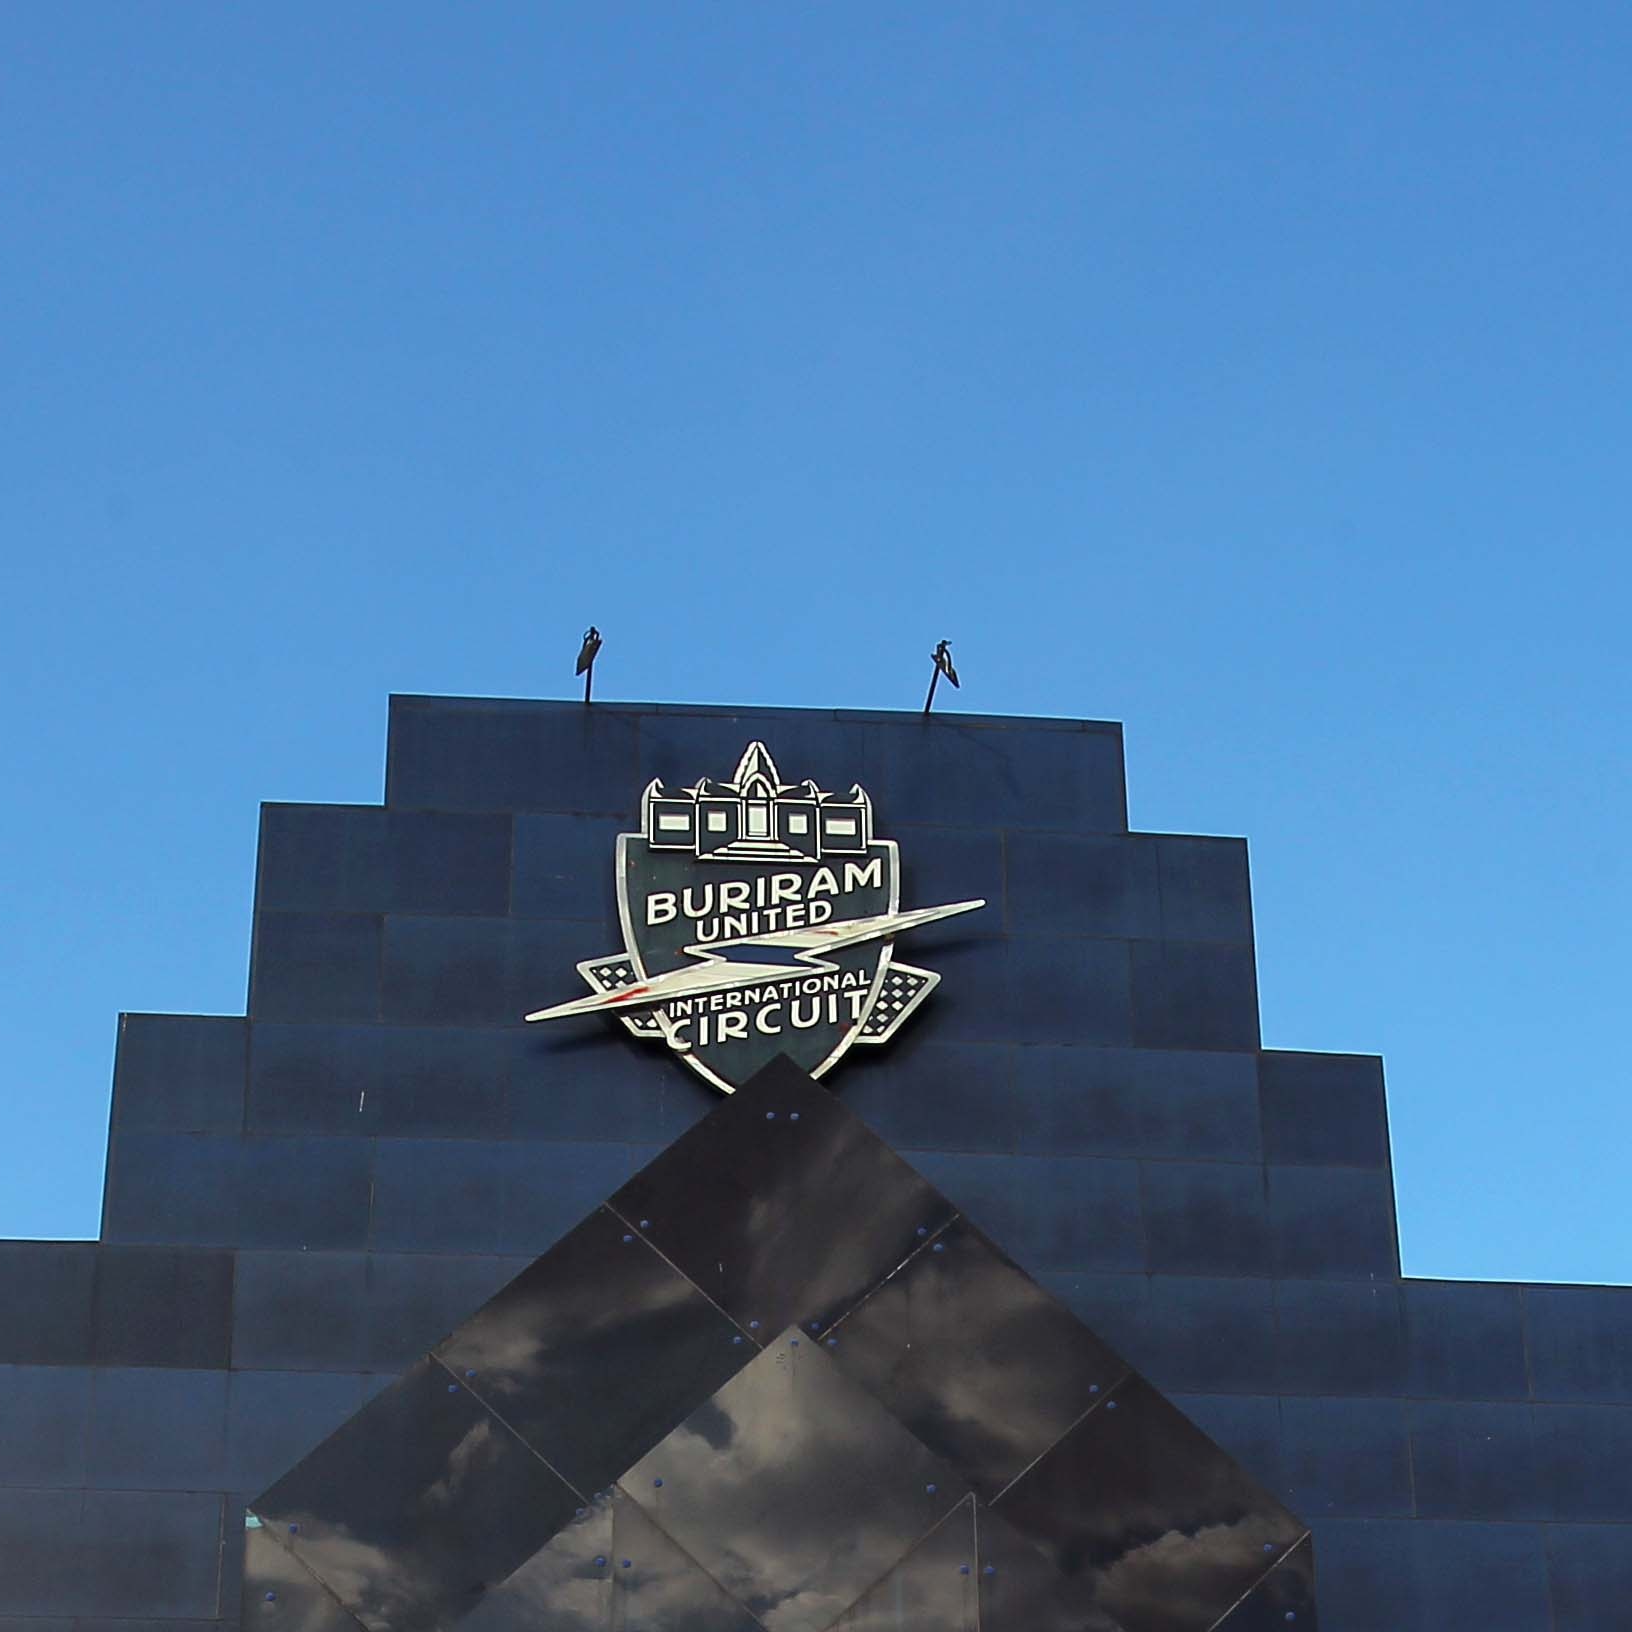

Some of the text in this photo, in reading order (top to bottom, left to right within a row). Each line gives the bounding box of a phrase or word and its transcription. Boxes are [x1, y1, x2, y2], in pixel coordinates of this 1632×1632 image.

[646, 858, 882, 926] BURIRAM
[696, 900, 833, 942] UNITED
[666, 989, 868, 1050] CIRCUIT
[669, 970, 871, 1018] INTERNATIONAL
